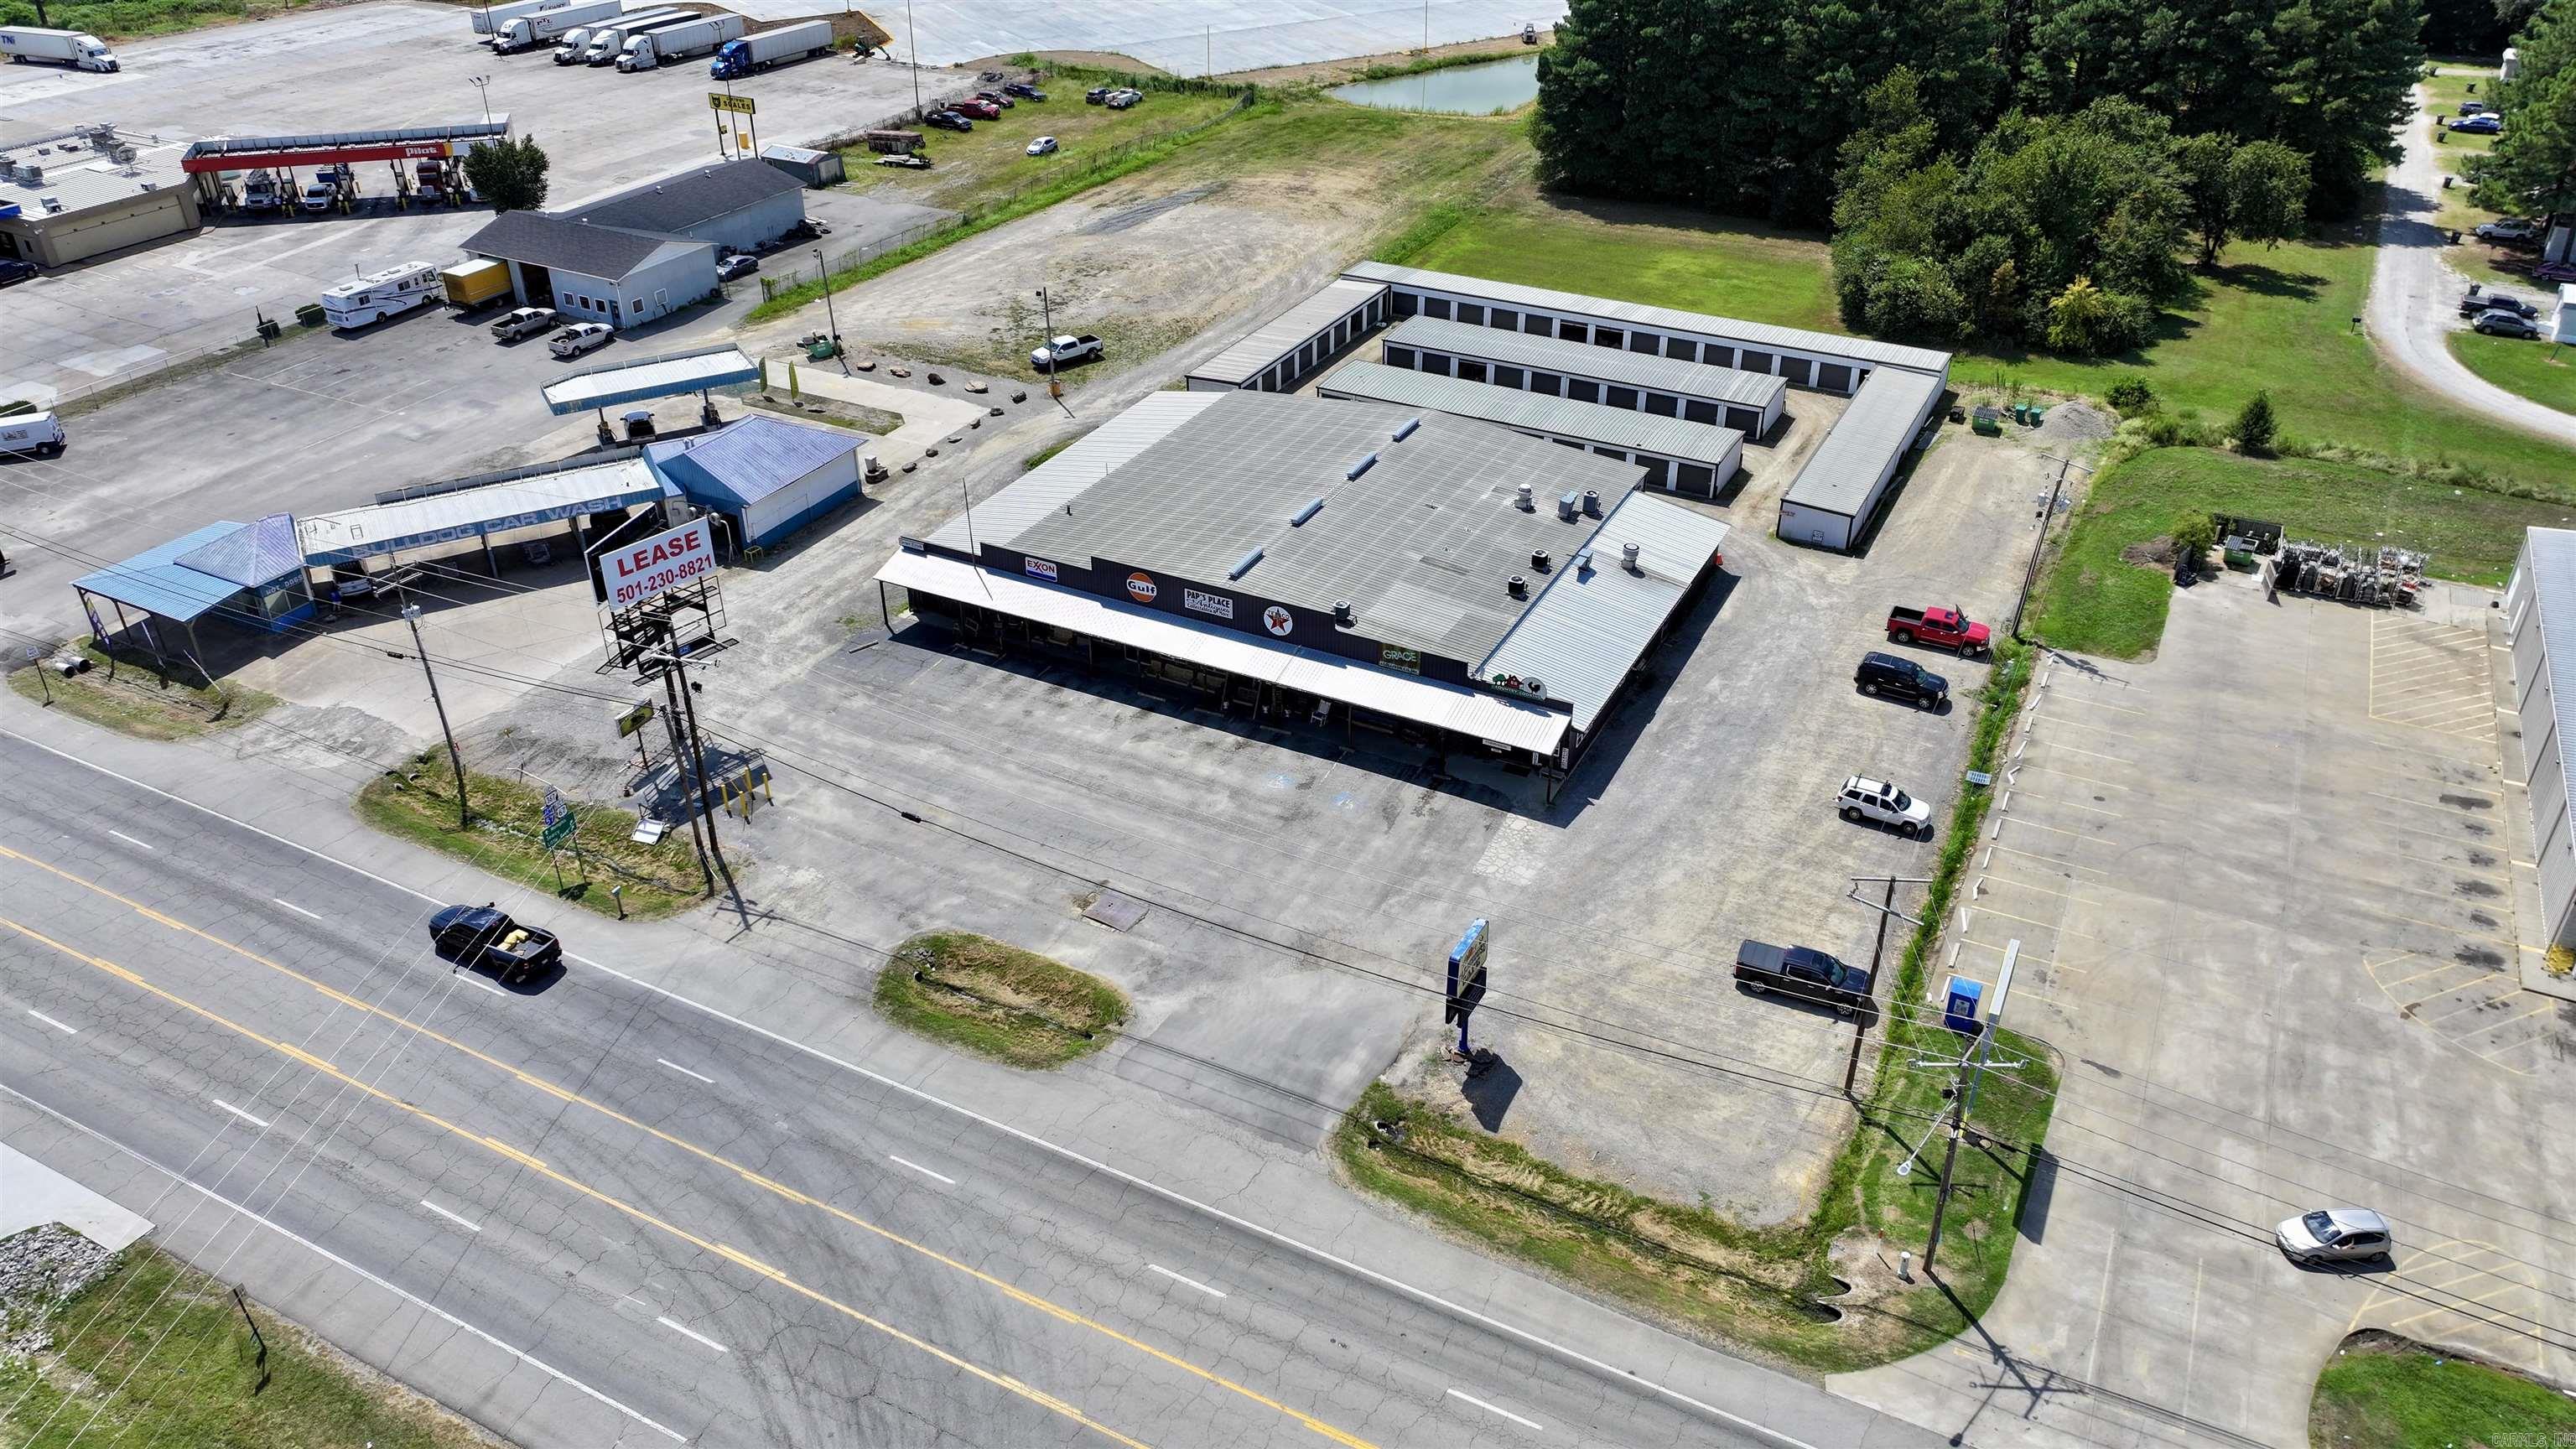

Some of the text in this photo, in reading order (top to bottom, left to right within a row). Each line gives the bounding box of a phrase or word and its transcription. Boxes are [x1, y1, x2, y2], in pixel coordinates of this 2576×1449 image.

[723, 100, 750, 110] SCALES
[352, 497, 622, 558] BULLDOG CAR WASH
[616, 530, 701, 577] LEASE
[1026, 559, 1056, 574] EXXON
[284, 574, 304, 587] DOGS
[616, 553, 712, 604] 501-230-8821
[1127, 580, 1156, 594] Gulf
[1187, 590, 1230, 608] PAP'S PLACE
[1267, 610, 1290, 620] TEXACO
[1383, 650, 1417, 662] GRACE
[1495, 684, 1517, 694] COUNTRY
